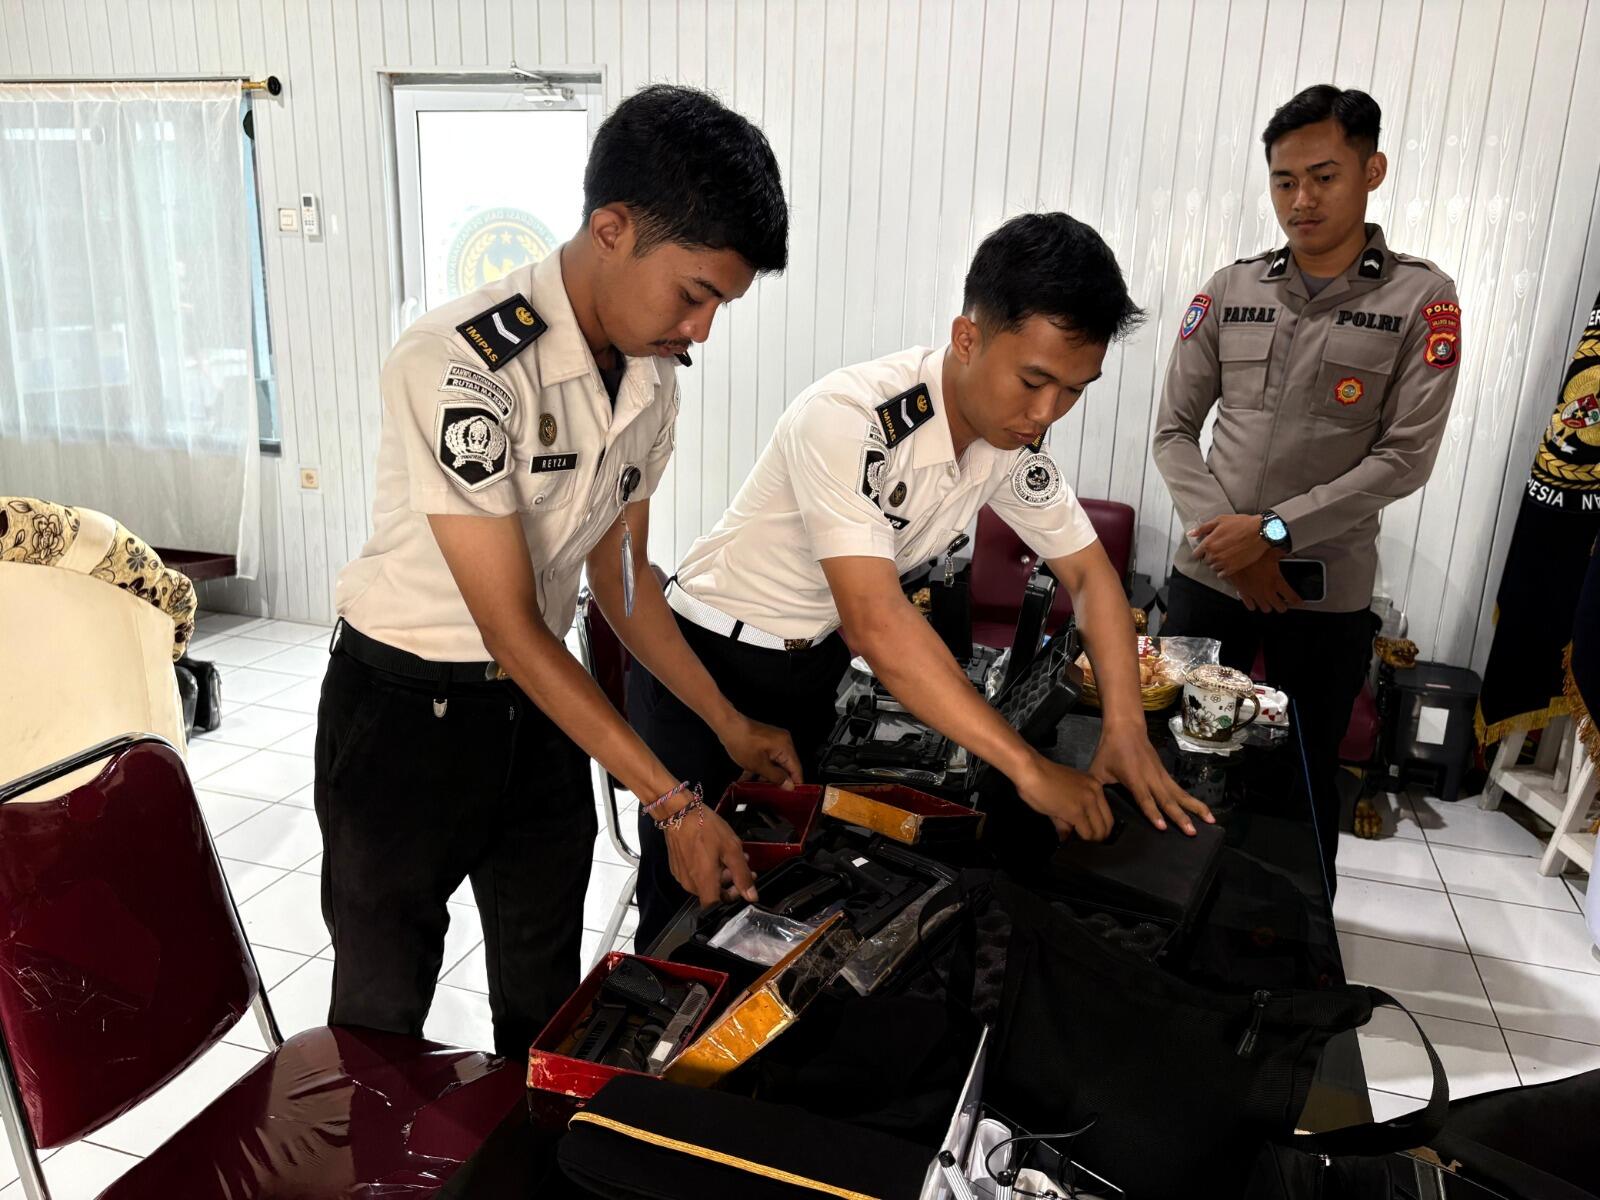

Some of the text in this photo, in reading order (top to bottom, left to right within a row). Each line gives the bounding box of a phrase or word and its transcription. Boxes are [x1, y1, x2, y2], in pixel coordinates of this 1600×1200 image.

[1222, 306, 1277, 323] FAISAL
[1335, 310, 1403, 333] POLRI
[465, 325, 499, 363] IMIPAS
[882, 408, 897, 442] IMIPAS
[541, 458, 567, 469] REYZA
